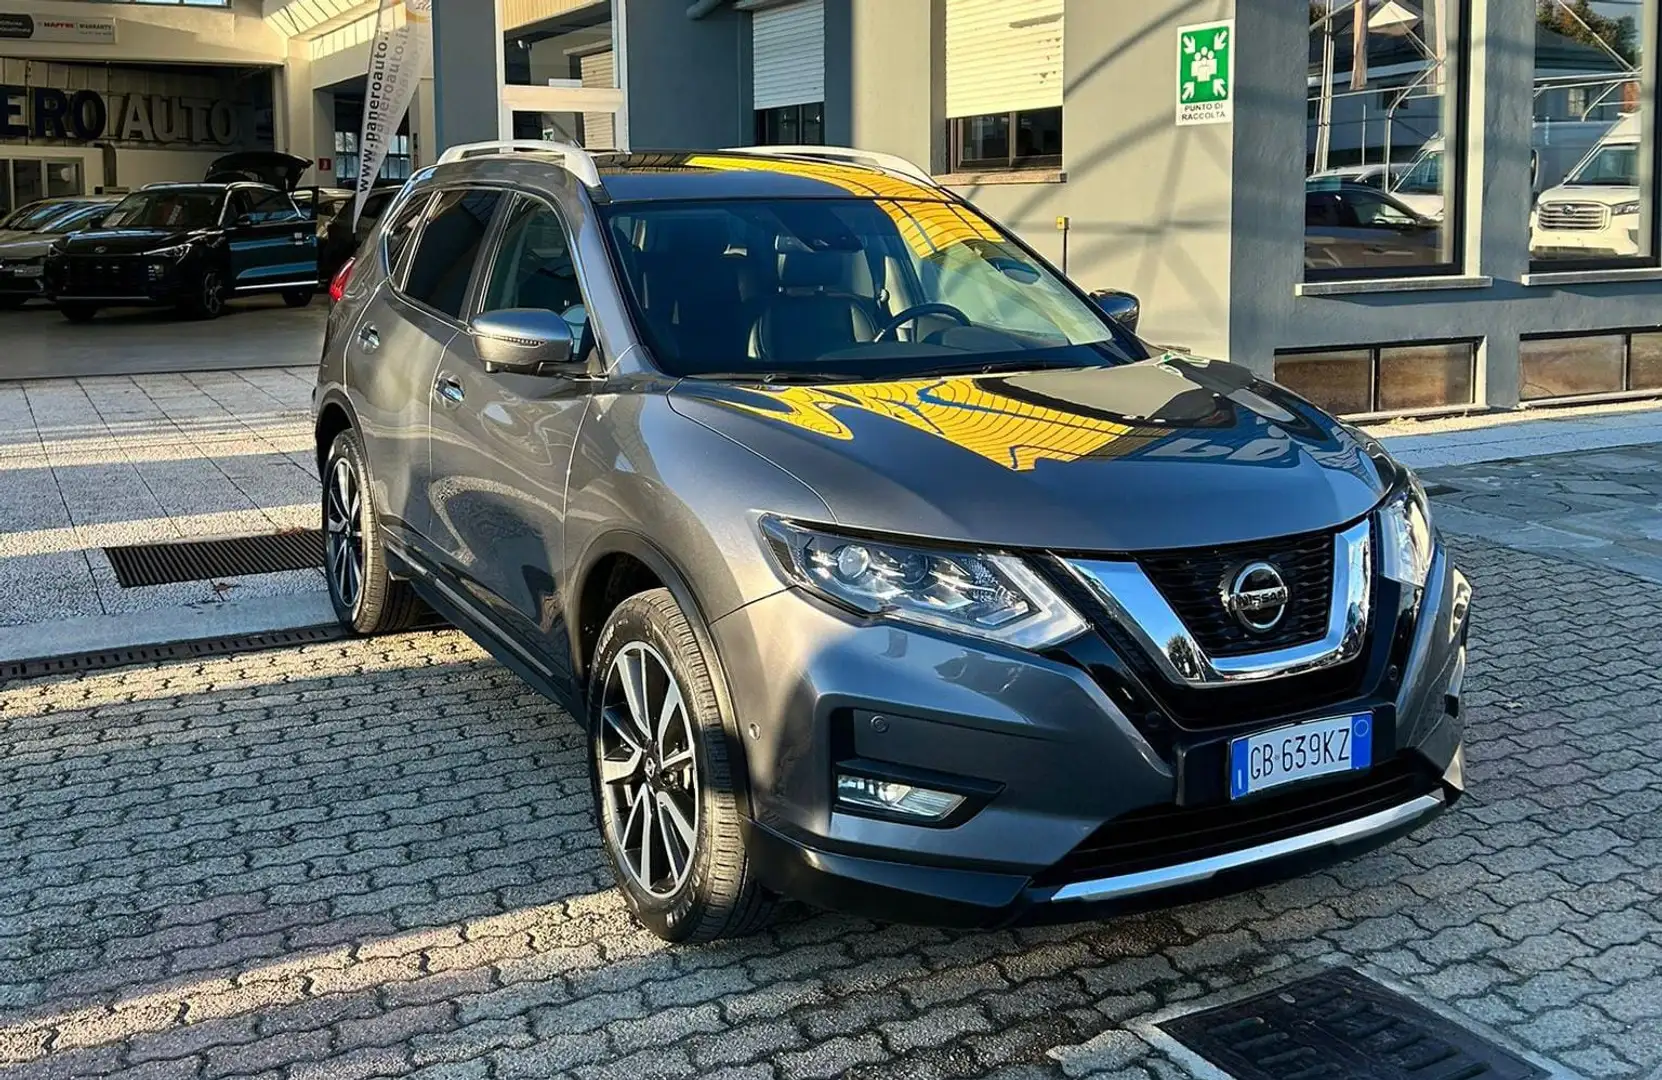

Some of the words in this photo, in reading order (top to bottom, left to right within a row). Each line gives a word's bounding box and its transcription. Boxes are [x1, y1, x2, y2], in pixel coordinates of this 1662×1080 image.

[1184, 103, 1213, 112] PUNTO
[1214, 102, 1223, 110] DI
[0, 86, 107, 140] ERO
[121, 92, 237, 145] AUTO
[1181, 111, 1226, 121] RACCOLTA
[1234, 589, 1286, 608] NISSAN
